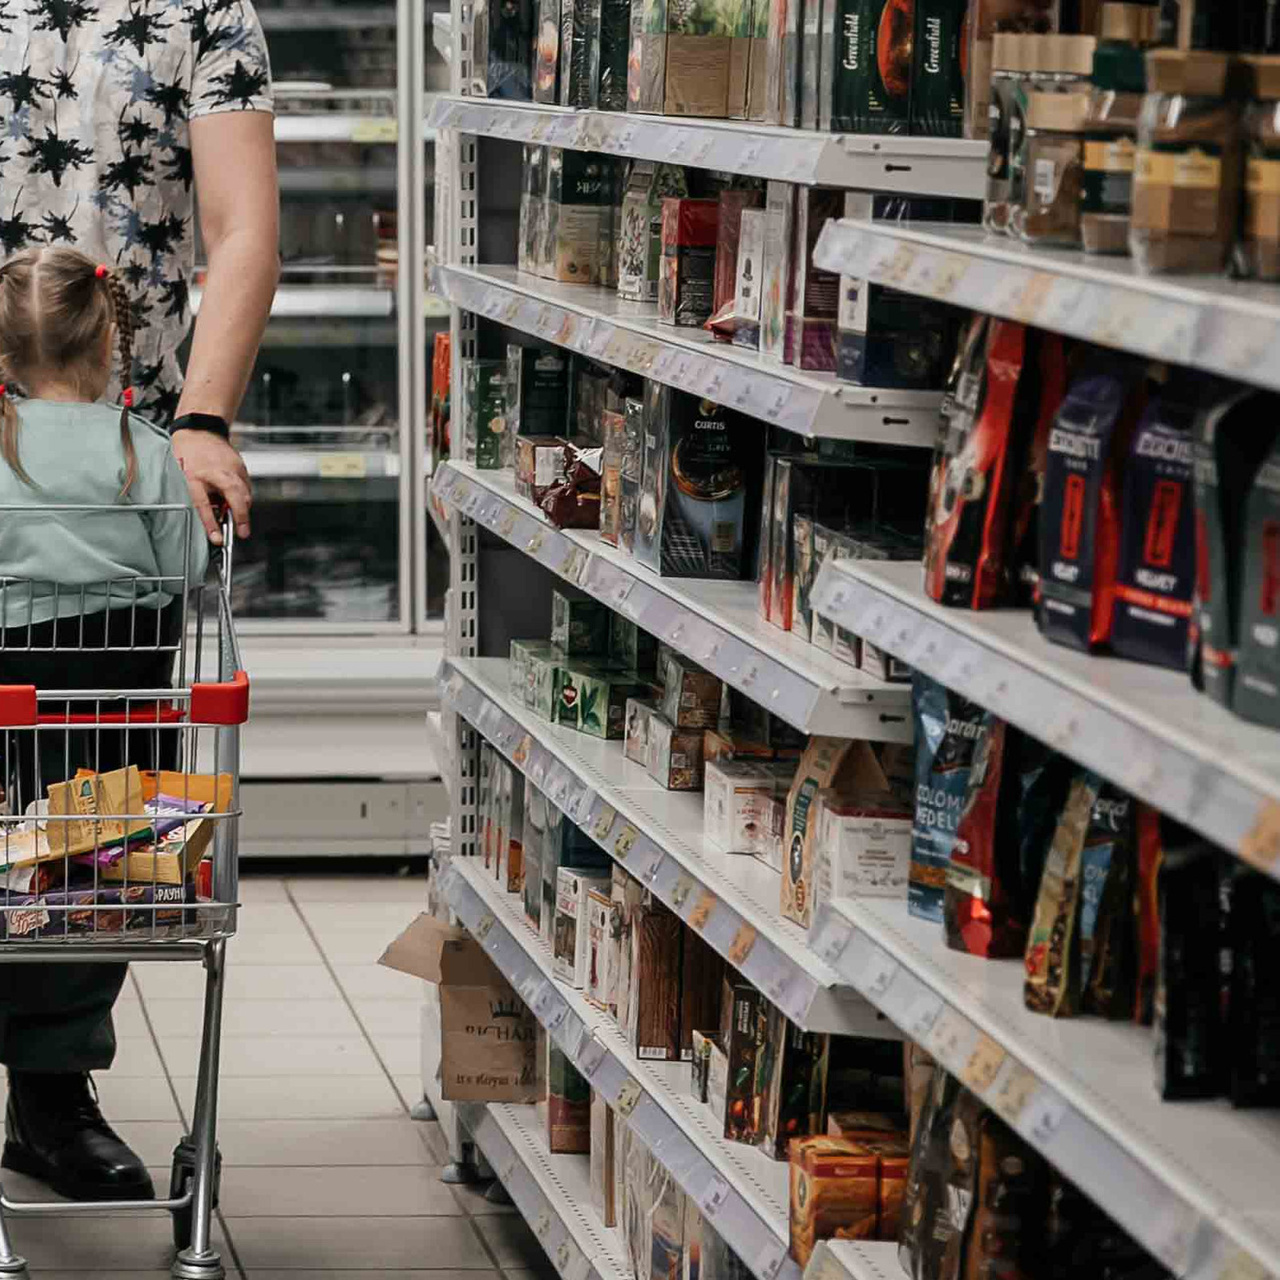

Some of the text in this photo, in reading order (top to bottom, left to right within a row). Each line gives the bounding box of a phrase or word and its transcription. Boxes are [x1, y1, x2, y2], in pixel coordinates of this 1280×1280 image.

[842, 13, 860, 70] Greenfield
[924, 17, 941, 74] Greenfield
[694, 420, 726, 431] CURTIS
